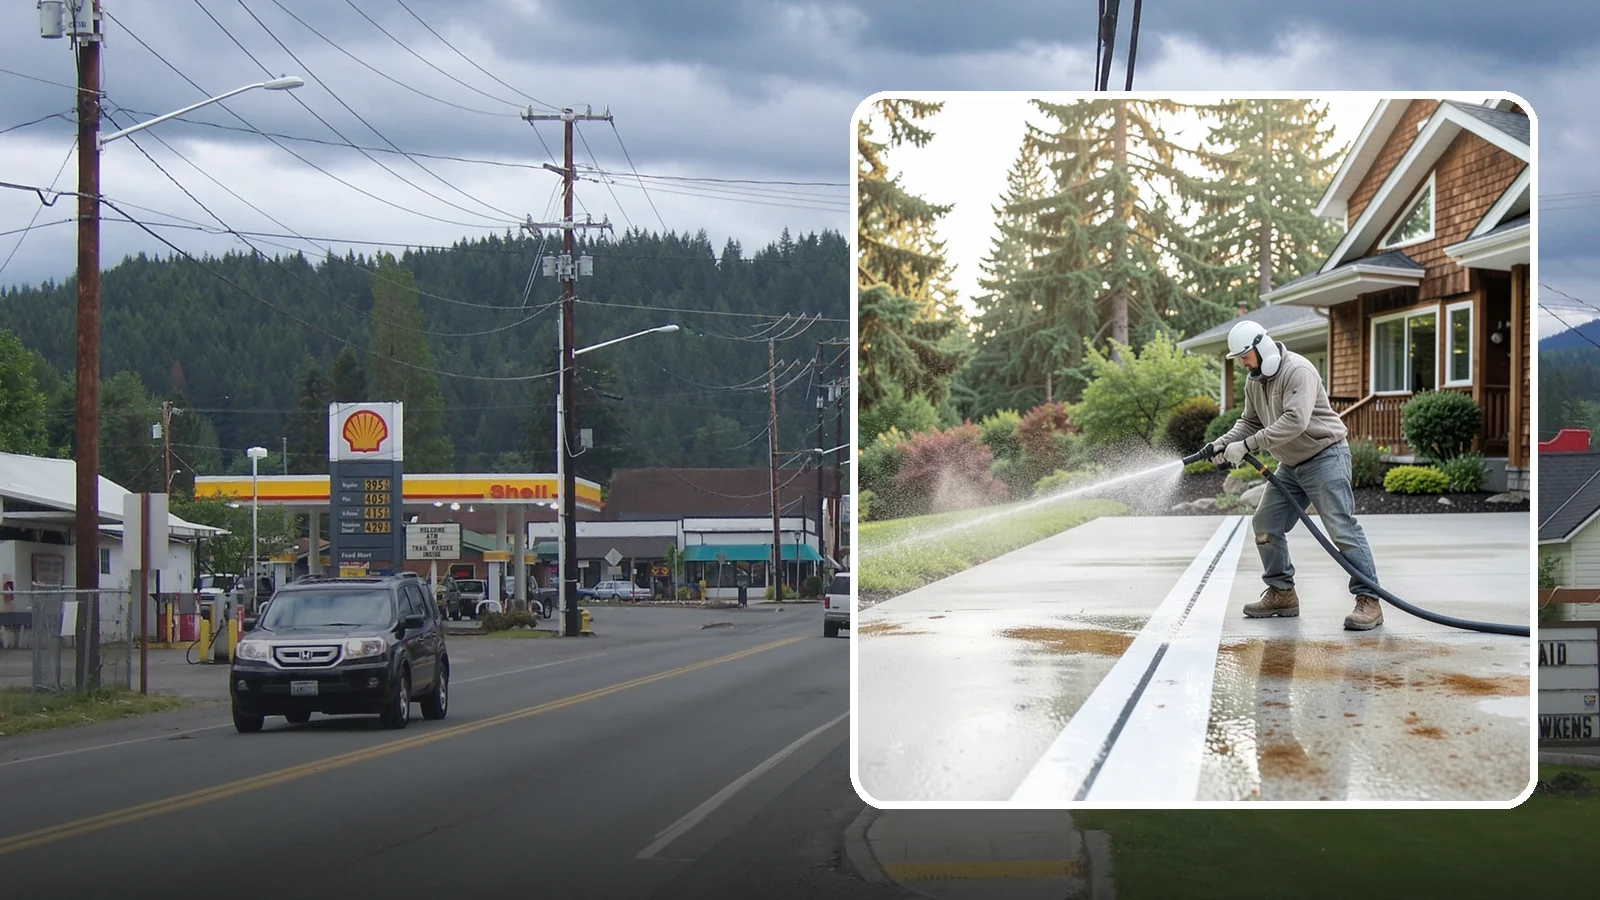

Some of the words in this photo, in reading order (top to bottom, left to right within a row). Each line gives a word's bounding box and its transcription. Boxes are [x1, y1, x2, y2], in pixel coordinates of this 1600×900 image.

[366, 480, 384, 490] 395
[490, 484, 547, 499] Shell
[366, 494, 384, 504] 405
[366, 508, 384, 518] 415
[366, 522, 384, 532] 429
